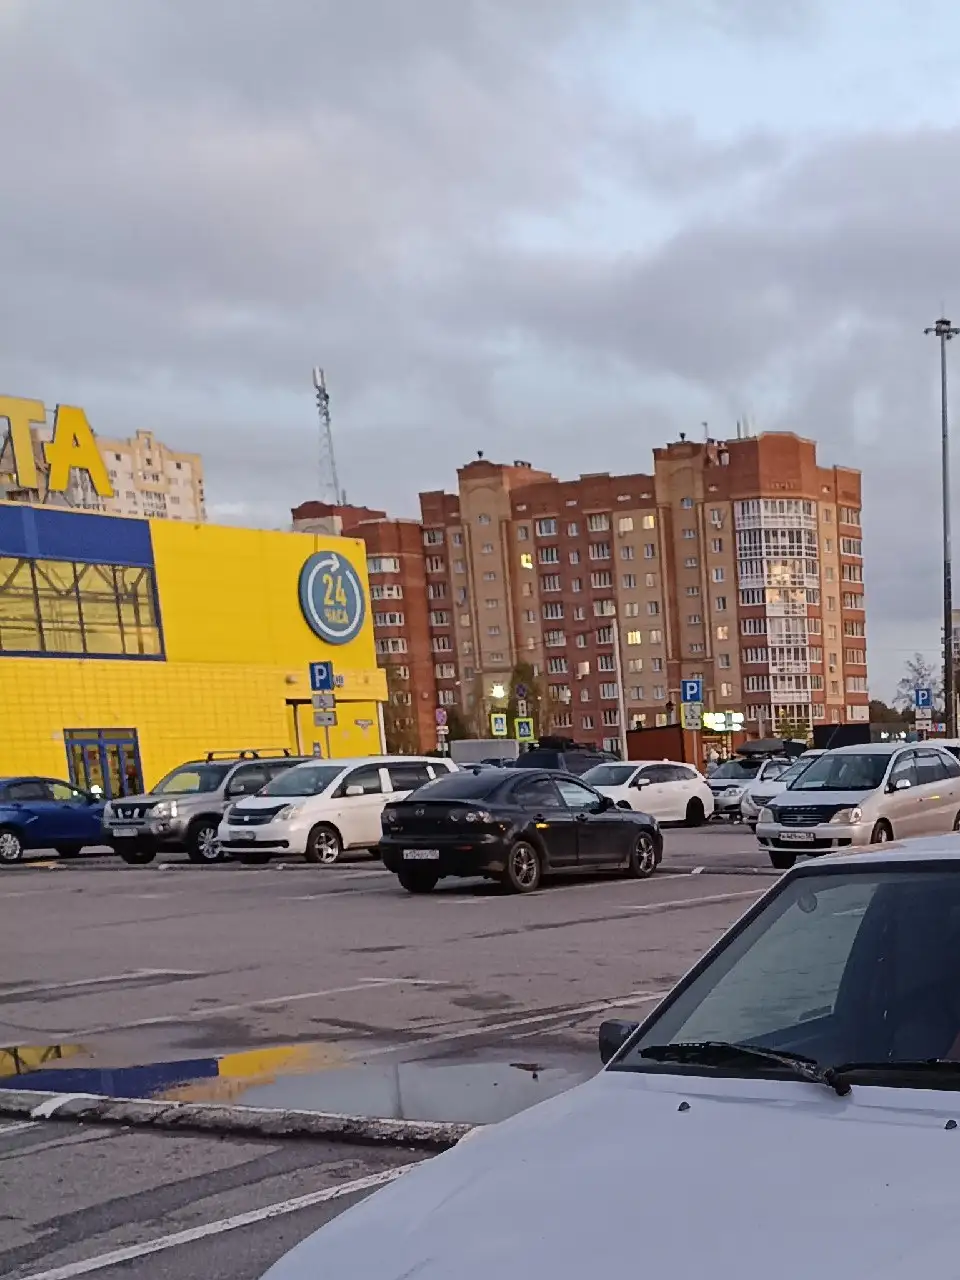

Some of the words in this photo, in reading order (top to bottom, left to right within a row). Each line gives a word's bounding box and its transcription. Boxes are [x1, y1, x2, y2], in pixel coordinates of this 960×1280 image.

[323, 573, 347, 606] 24
[314, 664, 327, 688] P
[686, 682, 699, 700] P
